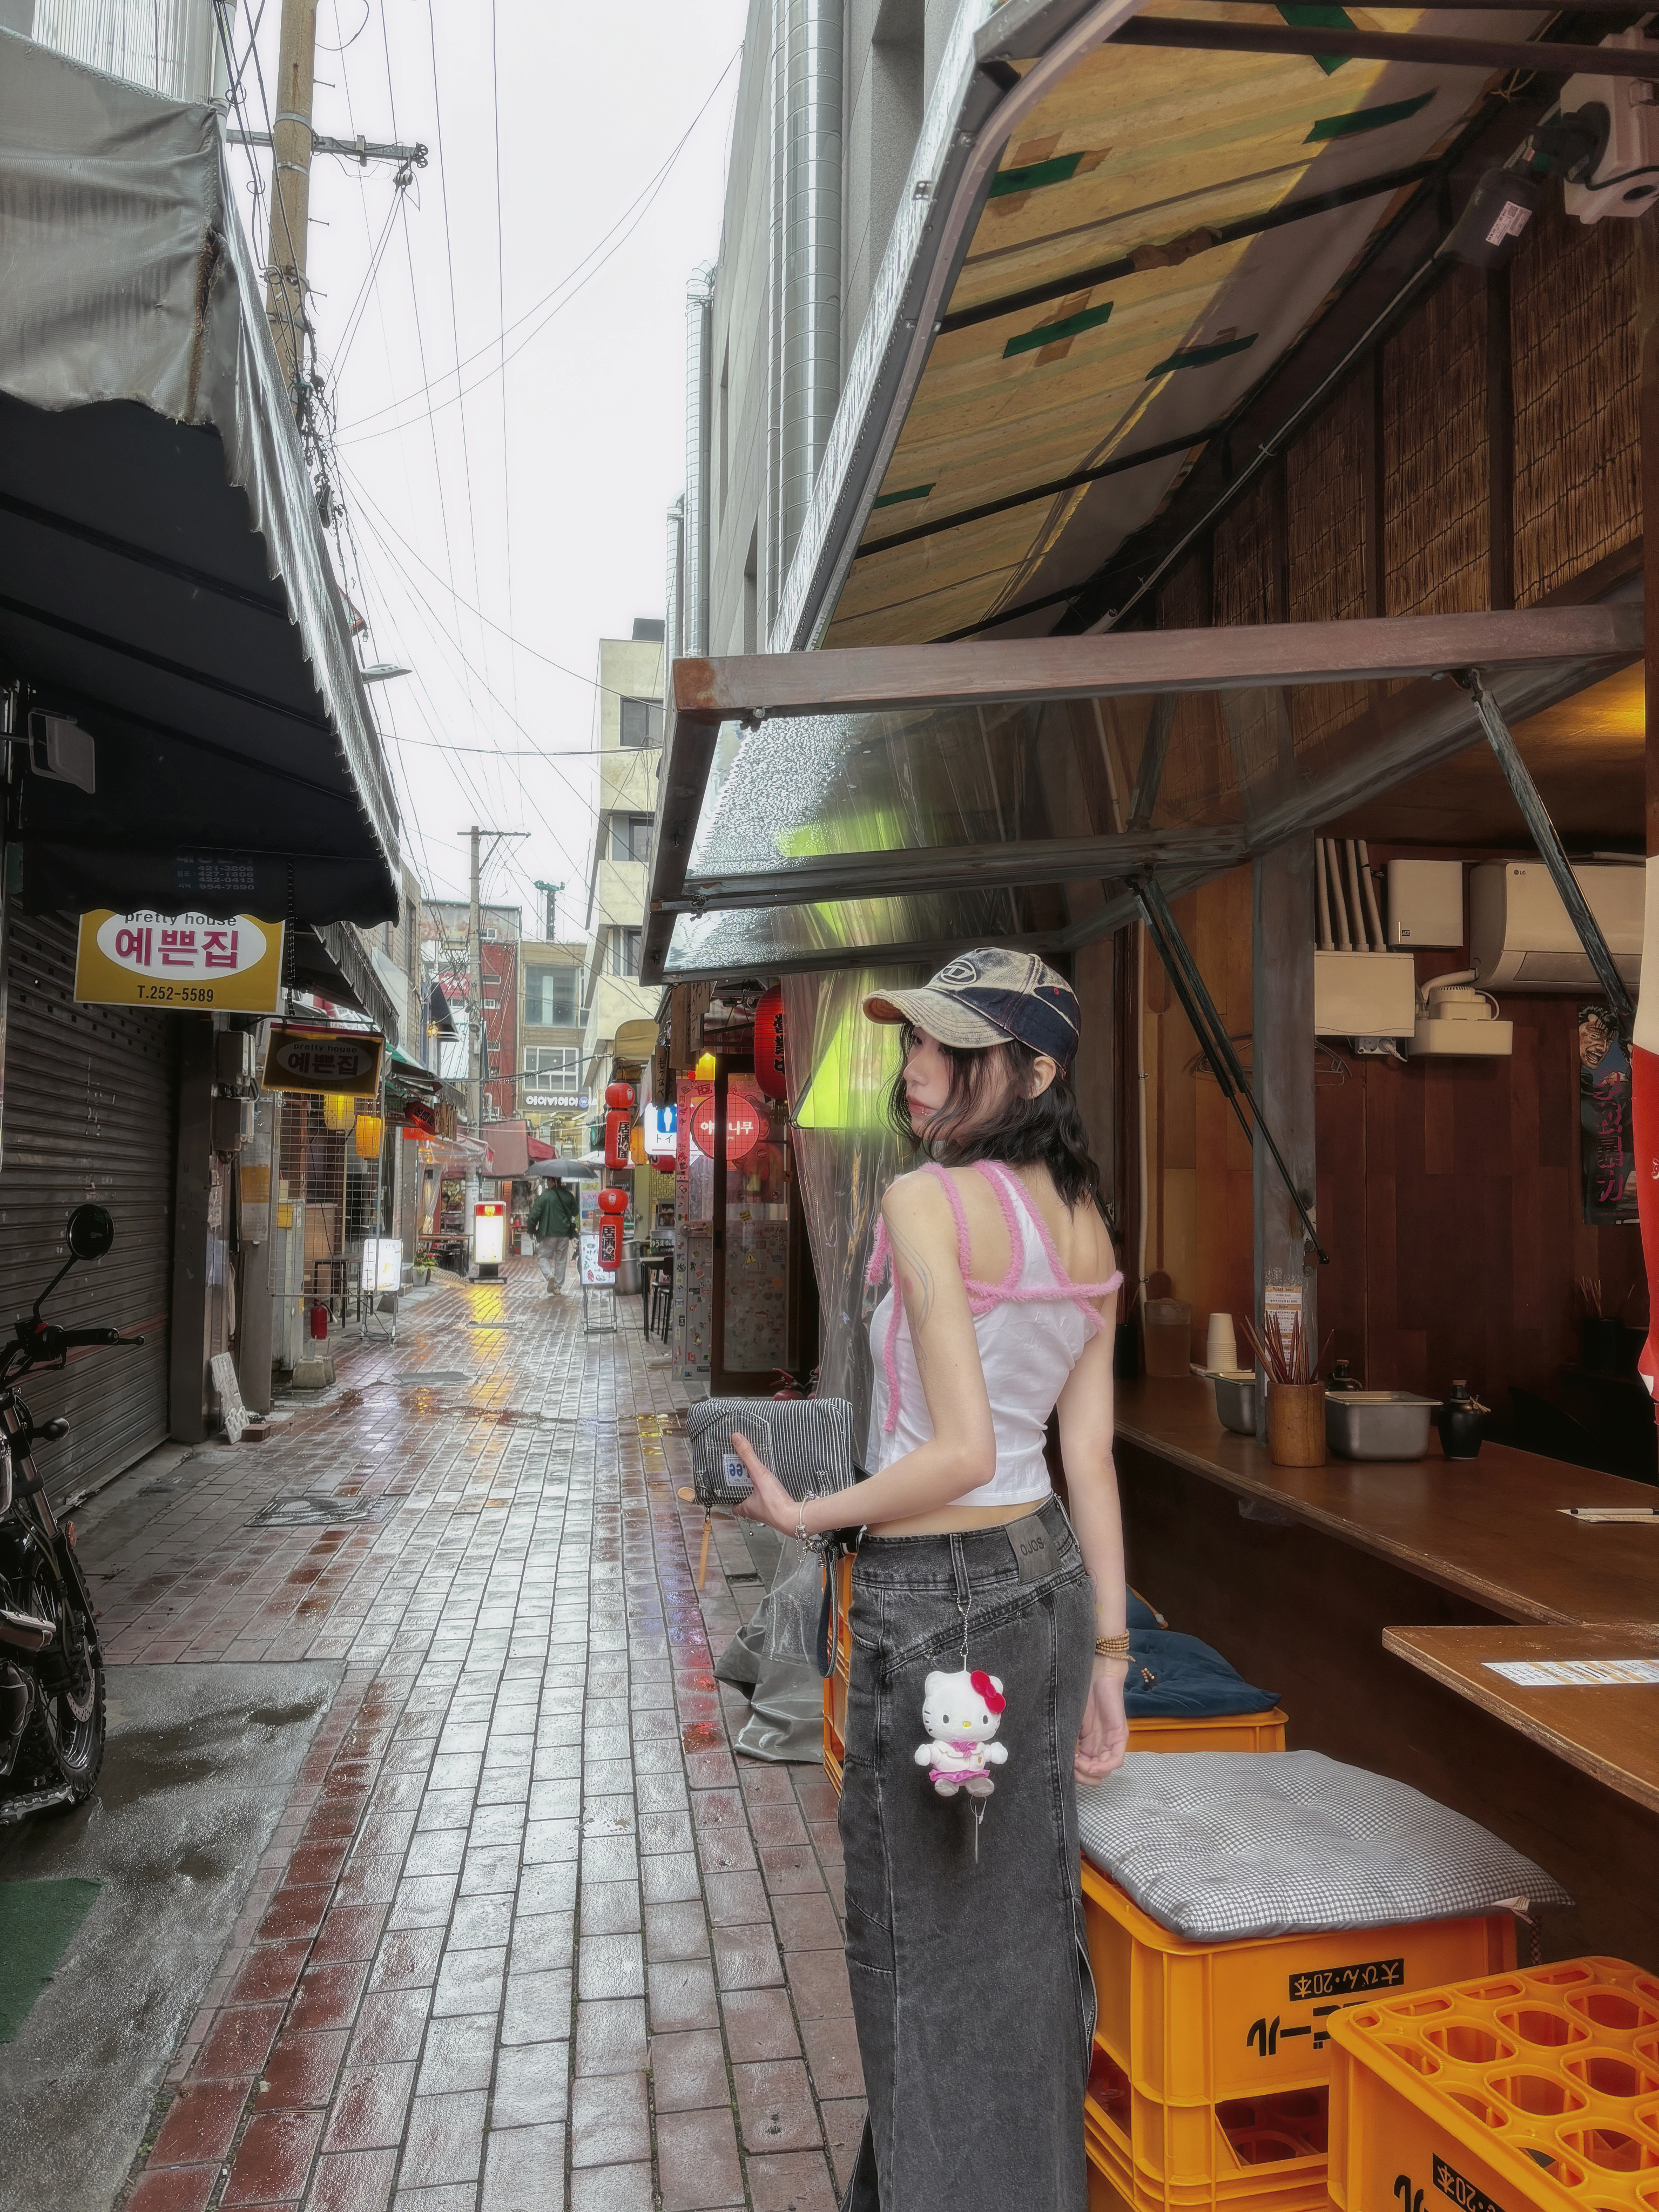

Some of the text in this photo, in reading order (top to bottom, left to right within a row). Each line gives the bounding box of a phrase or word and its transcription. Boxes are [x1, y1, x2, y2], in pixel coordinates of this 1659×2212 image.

[125, 913, 237, 926] pretty house
[115, 927, 239, 969] 예쁜집
[137, 984, 214, 1002] T.252-5589
[327, 1045, 357, 1053] house
[288, 1053, 359, 1076] 예쁜집
[700, 1120, 754, 1135] 야니쿠
[729, 1463, 751, 1478] ee
[1020, 1537, 1044, 1556] OJOS
